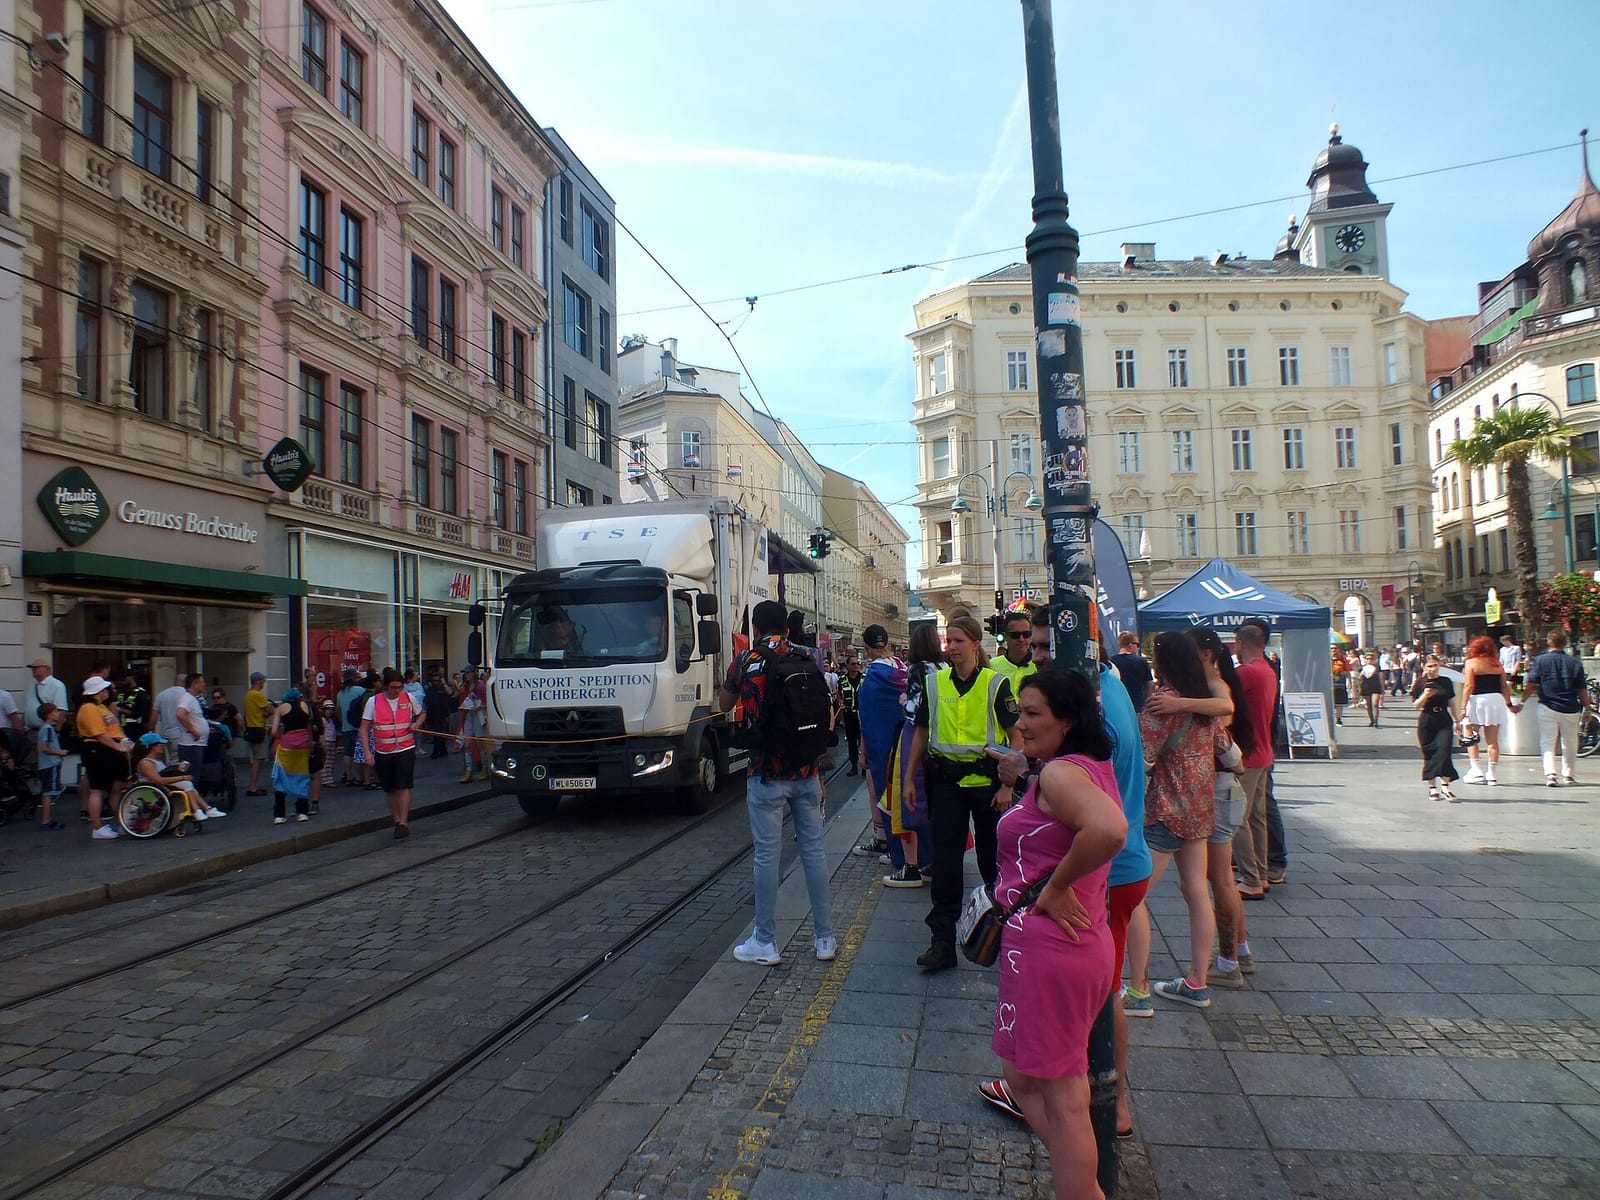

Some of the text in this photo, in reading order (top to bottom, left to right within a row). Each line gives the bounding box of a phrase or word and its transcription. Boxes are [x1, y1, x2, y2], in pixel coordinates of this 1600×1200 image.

[118, 500, 258, 543] Genuss Backstube
[449, 572, 471, 600] H&M
[1340, 579, 1368, 591] BIPA
[1012, 589, 1043, 601] BIPA
[1213, 615, 1280, 626] LIWT
[499, 674, 651, 690] TRANSPORT SPEDITION
[530, 687, 616, 701] EICHBERGER
